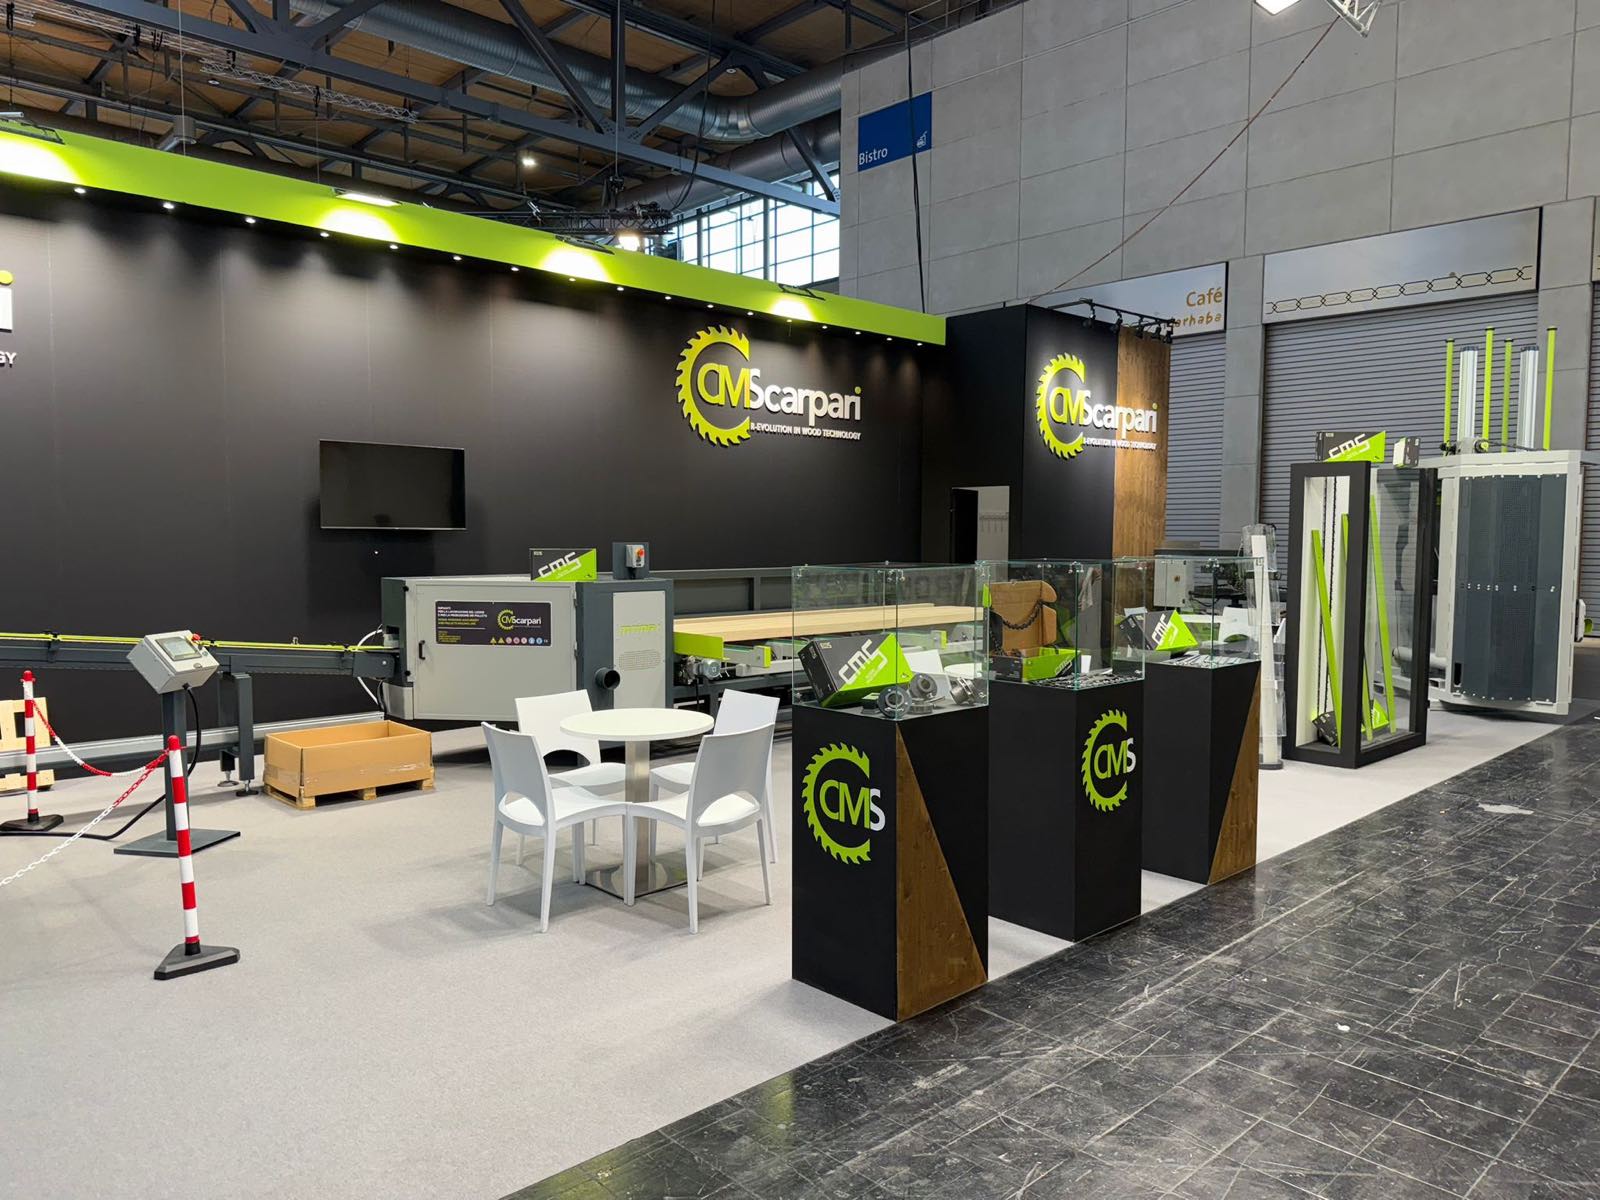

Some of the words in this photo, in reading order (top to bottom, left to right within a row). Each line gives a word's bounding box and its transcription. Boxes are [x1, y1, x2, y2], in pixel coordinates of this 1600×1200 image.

[859, 148, 888, 165] Bistro
[1186, 287, 1223, 307] Café
[1174, 312, 1222, 328] arhaba
[793, 426, 801, 434] IN
[801, 428, 822, 436] WOOD
[820, 780, 886, 832] CMS
